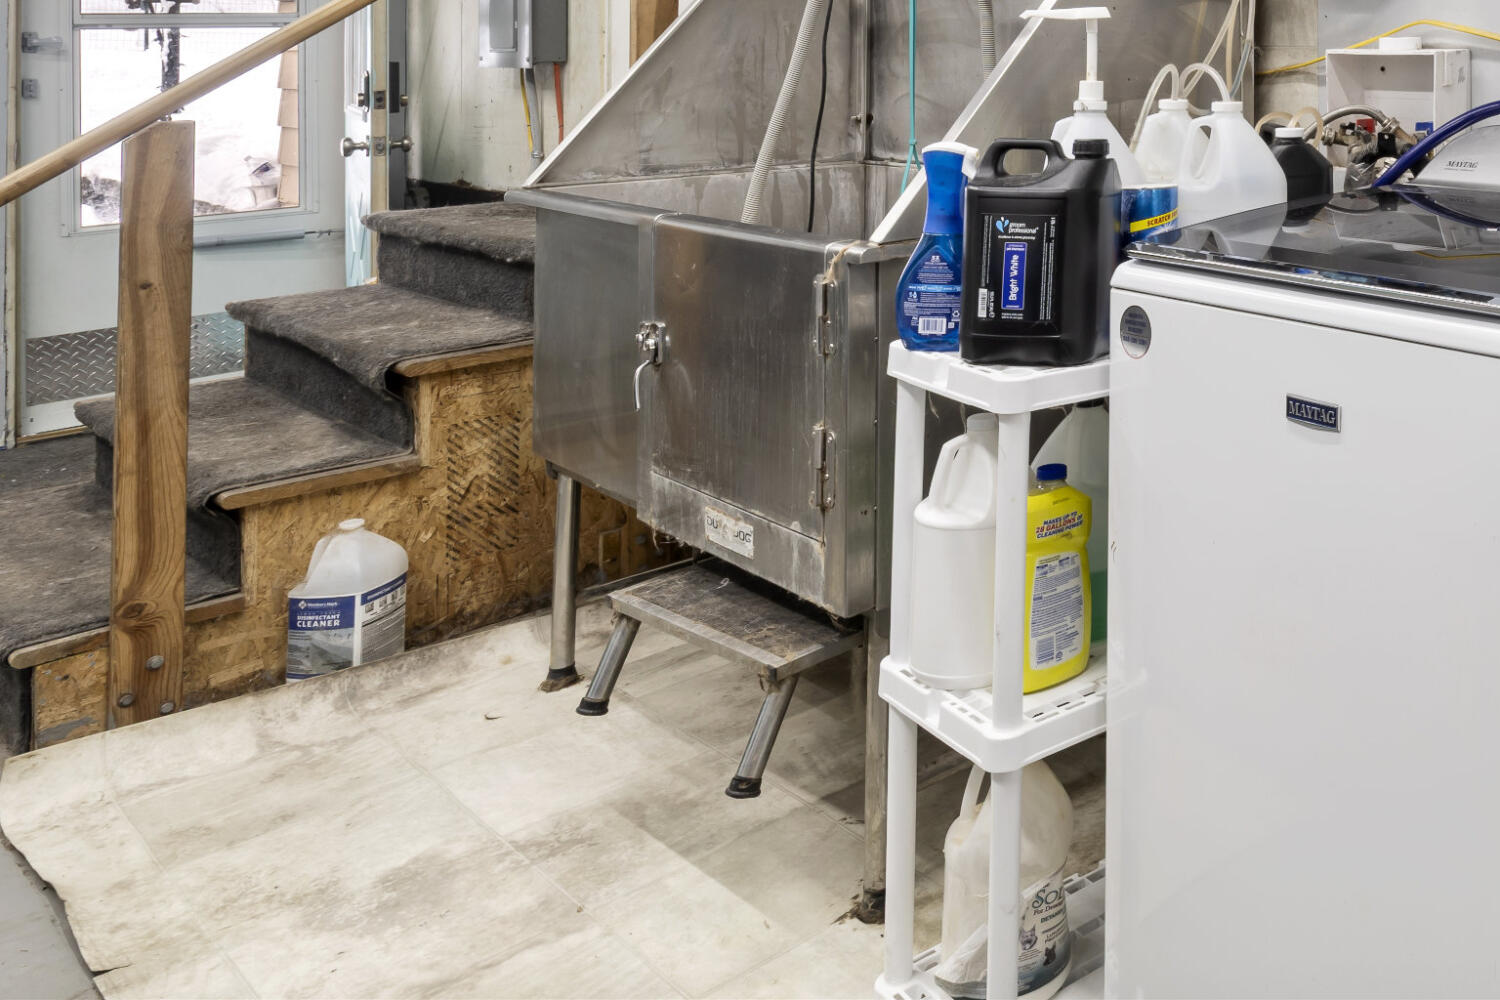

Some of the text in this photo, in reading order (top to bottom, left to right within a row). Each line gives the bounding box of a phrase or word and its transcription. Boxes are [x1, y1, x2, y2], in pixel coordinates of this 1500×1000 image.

[1446, 159, 1479, 169] MAYTAG
[1010, 254, 1019, 278] White
[1009, 278, 1019, 301] Bright
[1288, 400, 1336, 424] MAYTAG
[1036, 525, 1045, 534] 28
[1046, 517, 1076, 531] GALLONS
[1043, 517, 1061, 526] MAKES
[1036, 527, 1064, 539] CLEANING
[296, 620, 341, 628] CLEANER
